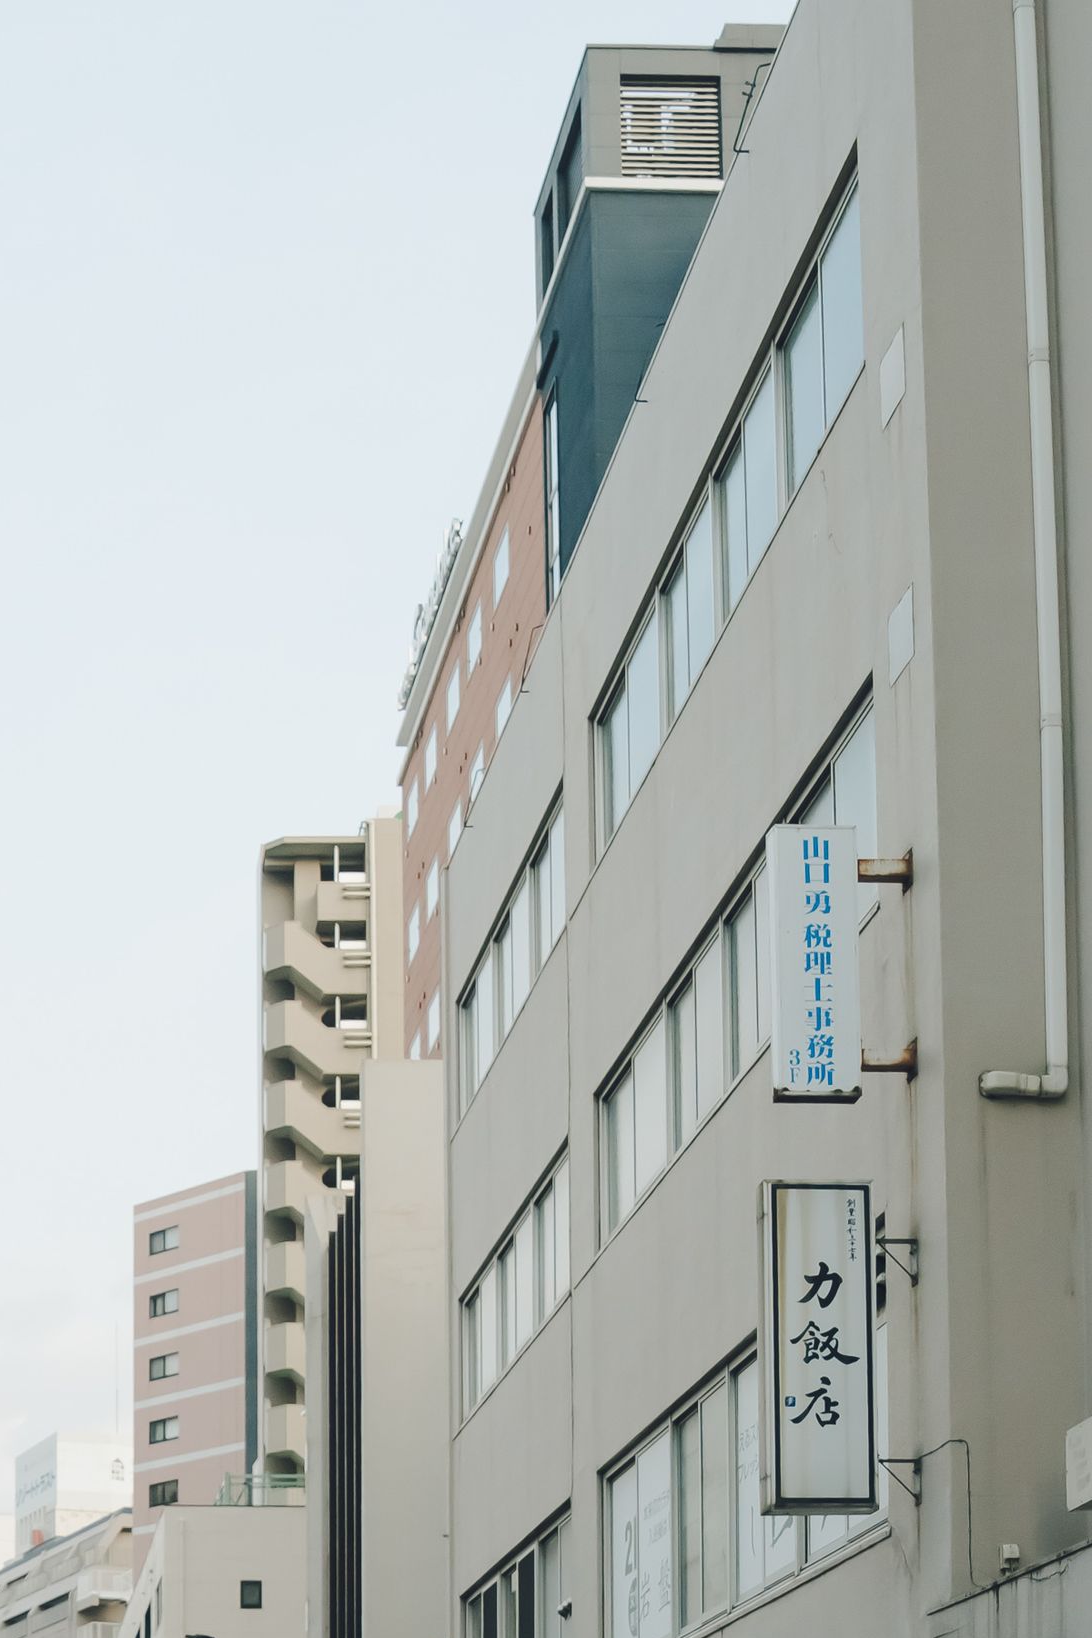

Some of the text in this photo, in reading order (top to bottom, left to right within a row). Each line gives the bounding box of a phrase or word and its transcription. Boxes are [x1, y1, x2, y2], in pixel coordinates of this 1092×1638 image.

[803, 836, 836, 1086] 山口勇税理士事務所
[789, 1049, 801, 1083] 3F
[790, 1262, 860, 1427] 力飯店
